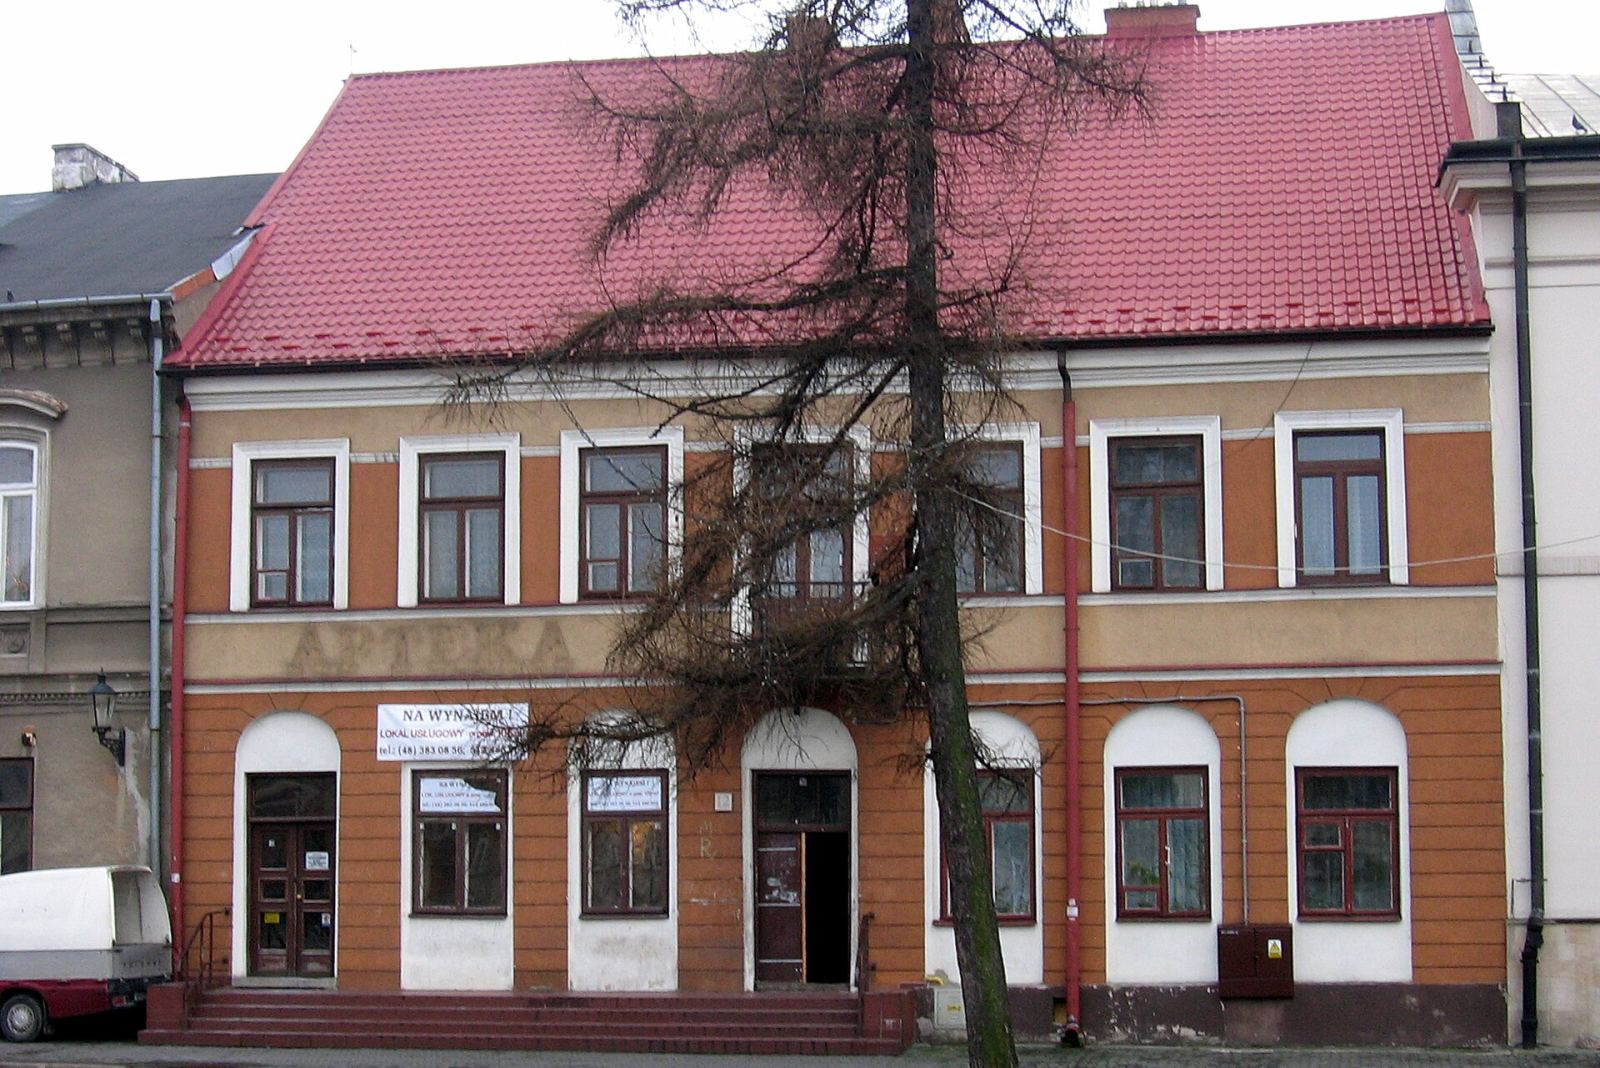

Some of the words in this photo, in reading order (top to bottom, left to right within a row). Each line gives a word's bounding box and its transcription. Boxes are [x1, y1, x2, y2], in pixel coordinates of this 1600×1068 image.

[287, 617, 573, 676] APTEKA
[402, 710, 424, 722] NA
[380, 728, 408, 738] LOKAL
[411, 728, 465, 738] USŁUGOWY
[398, 745, 417, 756] (48)
[419, 746, 436, 755] 383
